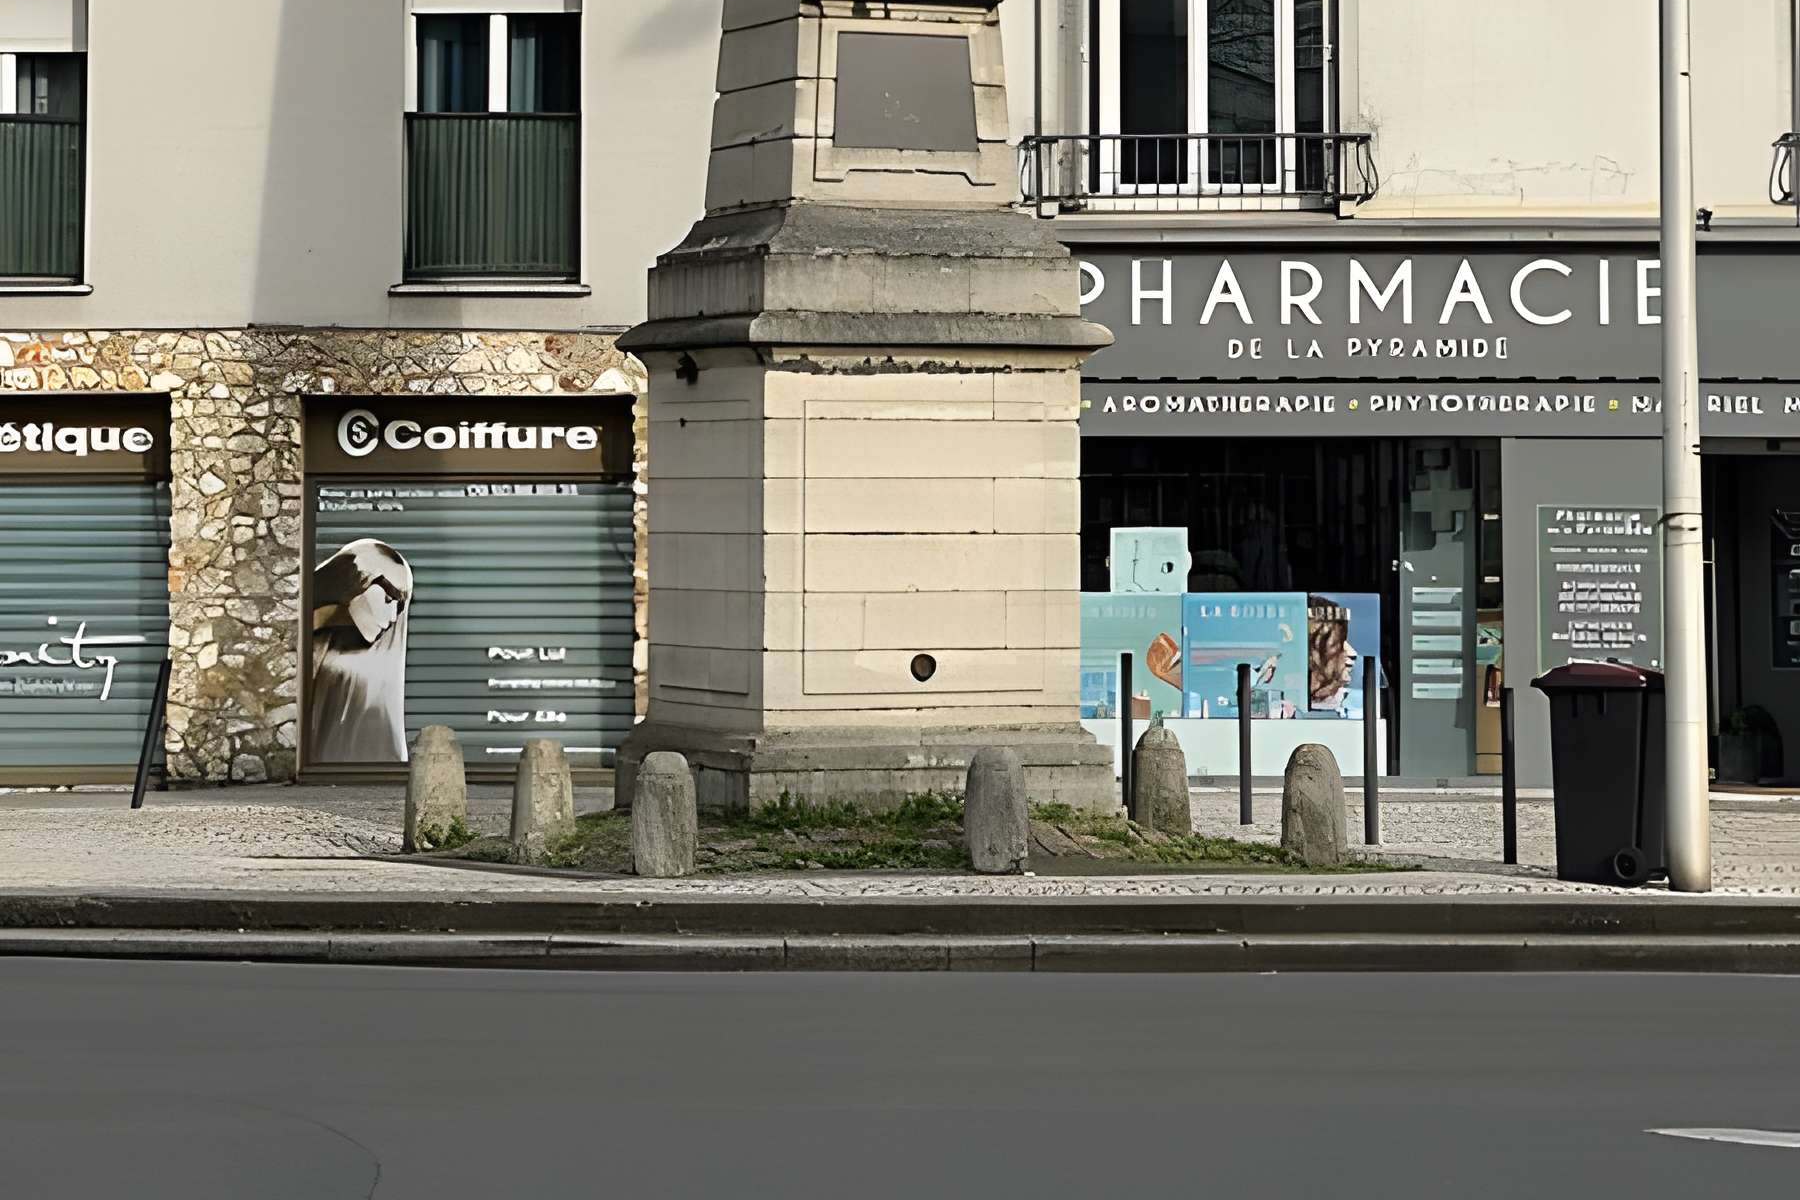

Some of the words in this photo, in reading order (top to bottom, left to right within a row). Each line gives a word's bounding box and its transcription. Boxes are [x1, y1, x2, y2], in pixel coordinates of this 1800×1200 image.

[1227, 337, 1263, 360] DE
[1287, 338, 1324, 359] LA
[1347, 337, 1508, 360] PYRAMIDE
[383, 420, 598, 450] Coiffure
